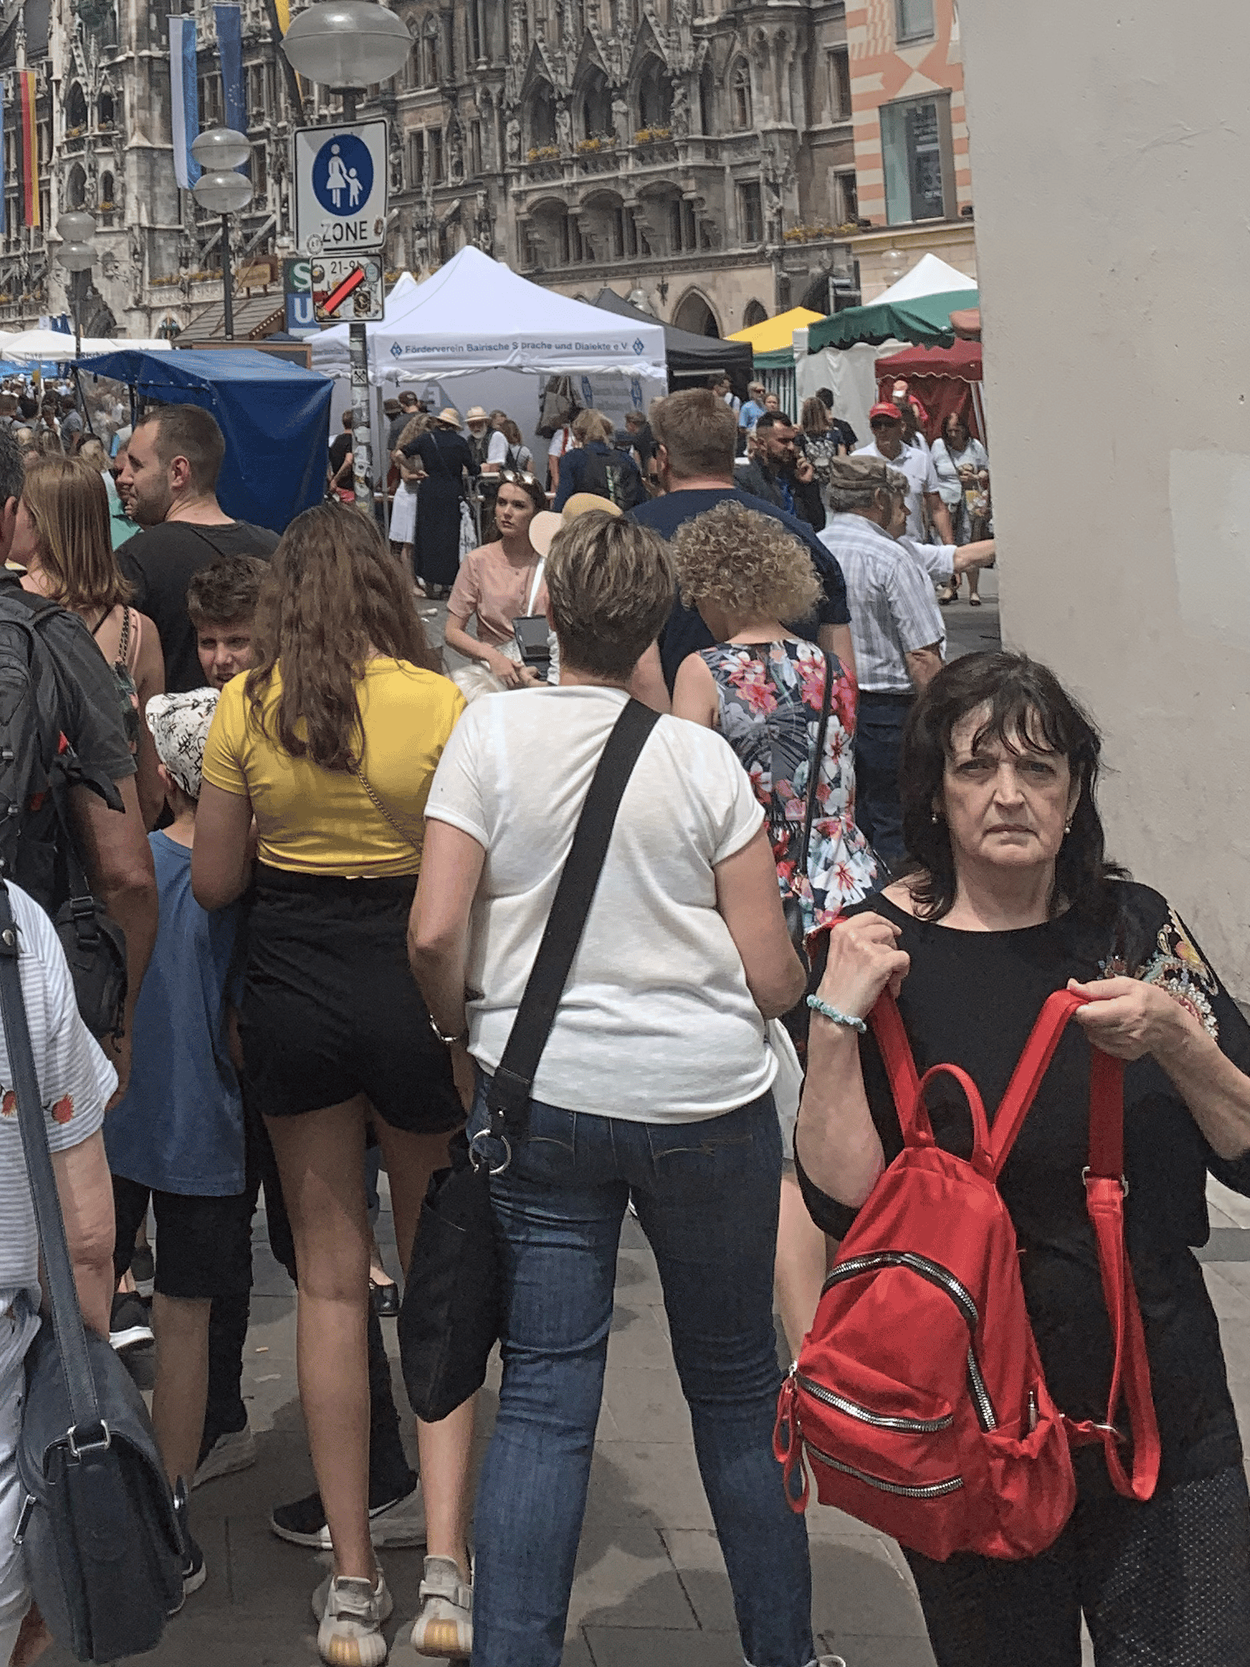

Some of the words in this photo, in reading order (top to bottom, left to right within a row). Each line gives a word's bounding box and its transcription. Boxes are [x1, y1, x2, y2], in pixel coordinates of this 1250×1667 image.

[321, 221, 367, 242] ZONE
[293, 262, 312, 289] S
[330, 260, 359, 274] 21-9
[294, 297, 314, 323] U
[554, 342, 572, 350] und
